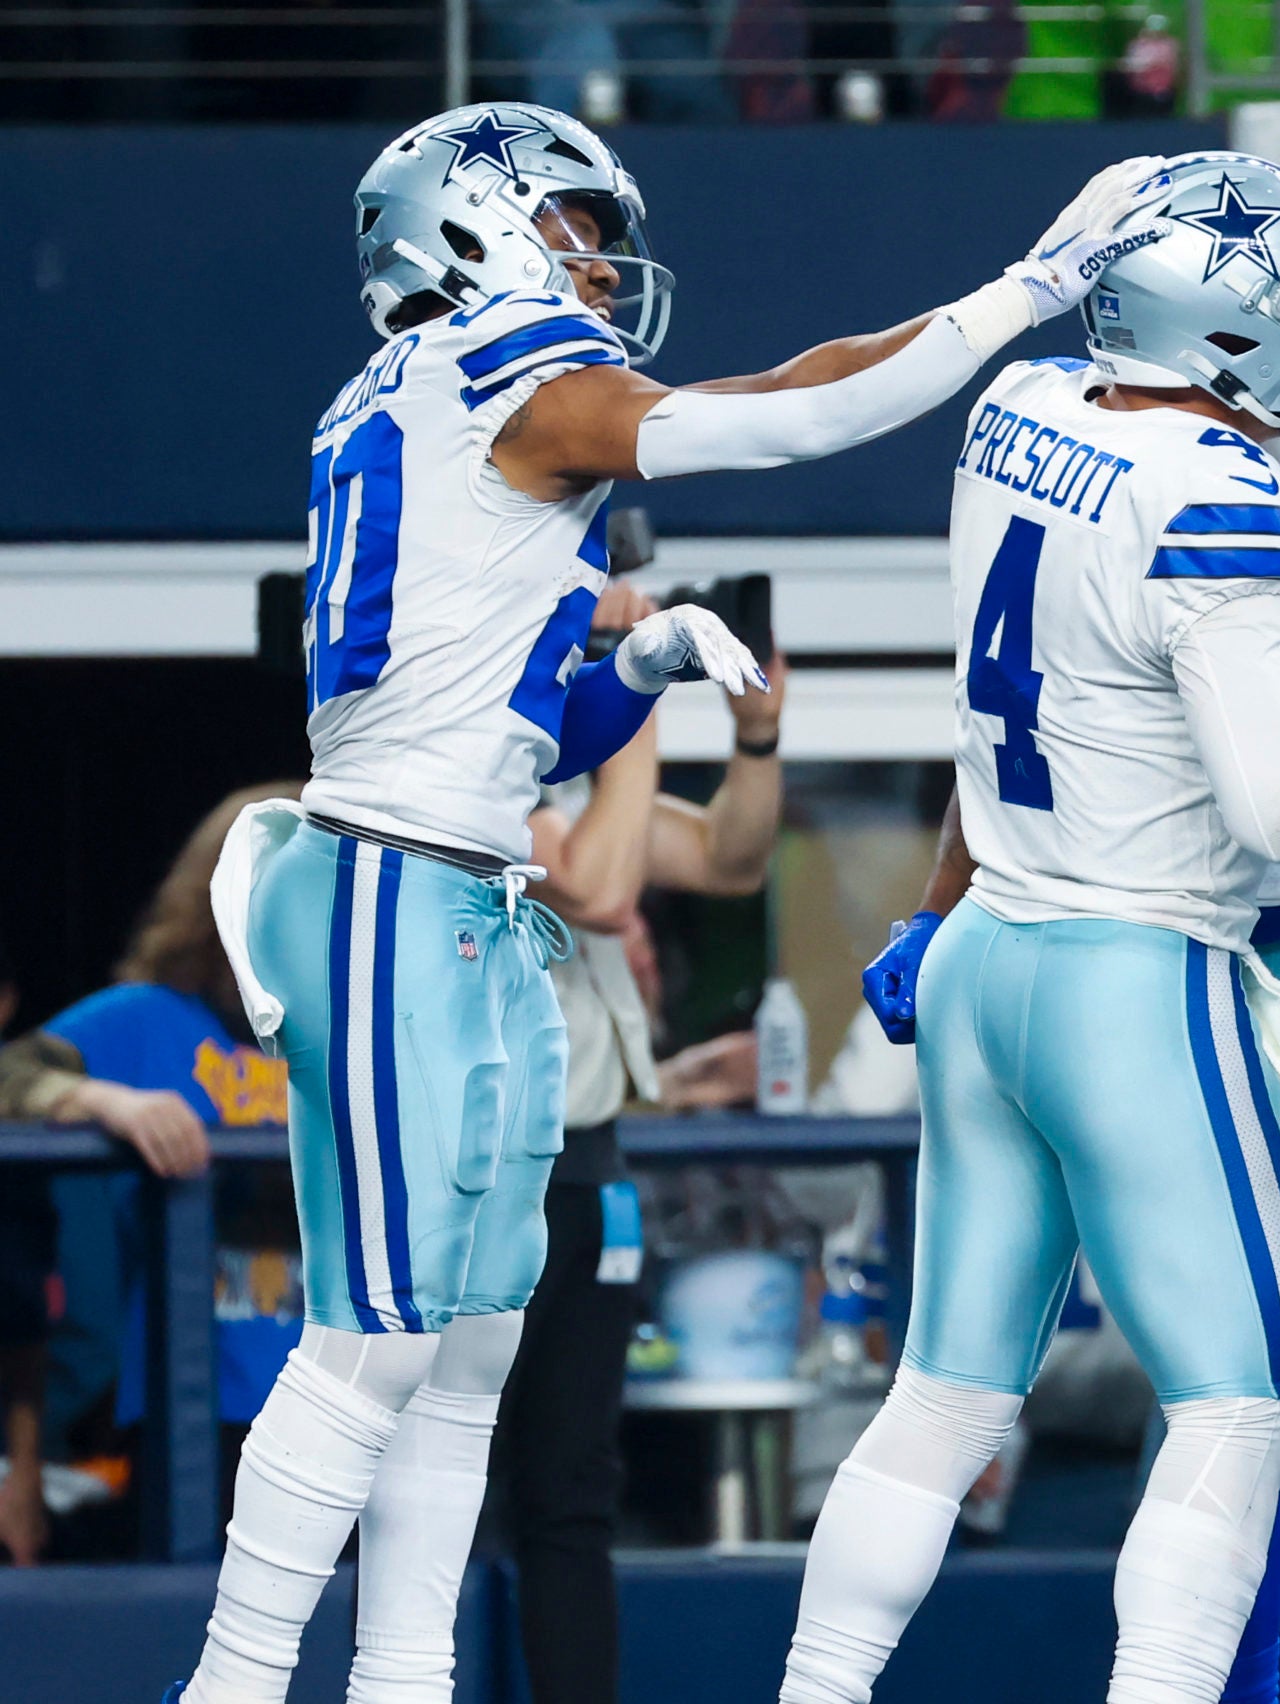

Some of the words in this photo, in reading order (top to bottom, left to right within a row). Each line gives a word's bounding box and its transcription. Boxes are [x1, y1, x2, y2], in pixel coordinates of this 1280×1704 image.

[1078, 228, 1158, 281] COWBOYS
[313, 332, 421, 438] OLLARD
[959, 402, 1135, 524] PRESCOTT
[1197, 427, 1270, 468] 4
[967, 514, 1054, 812] 4
